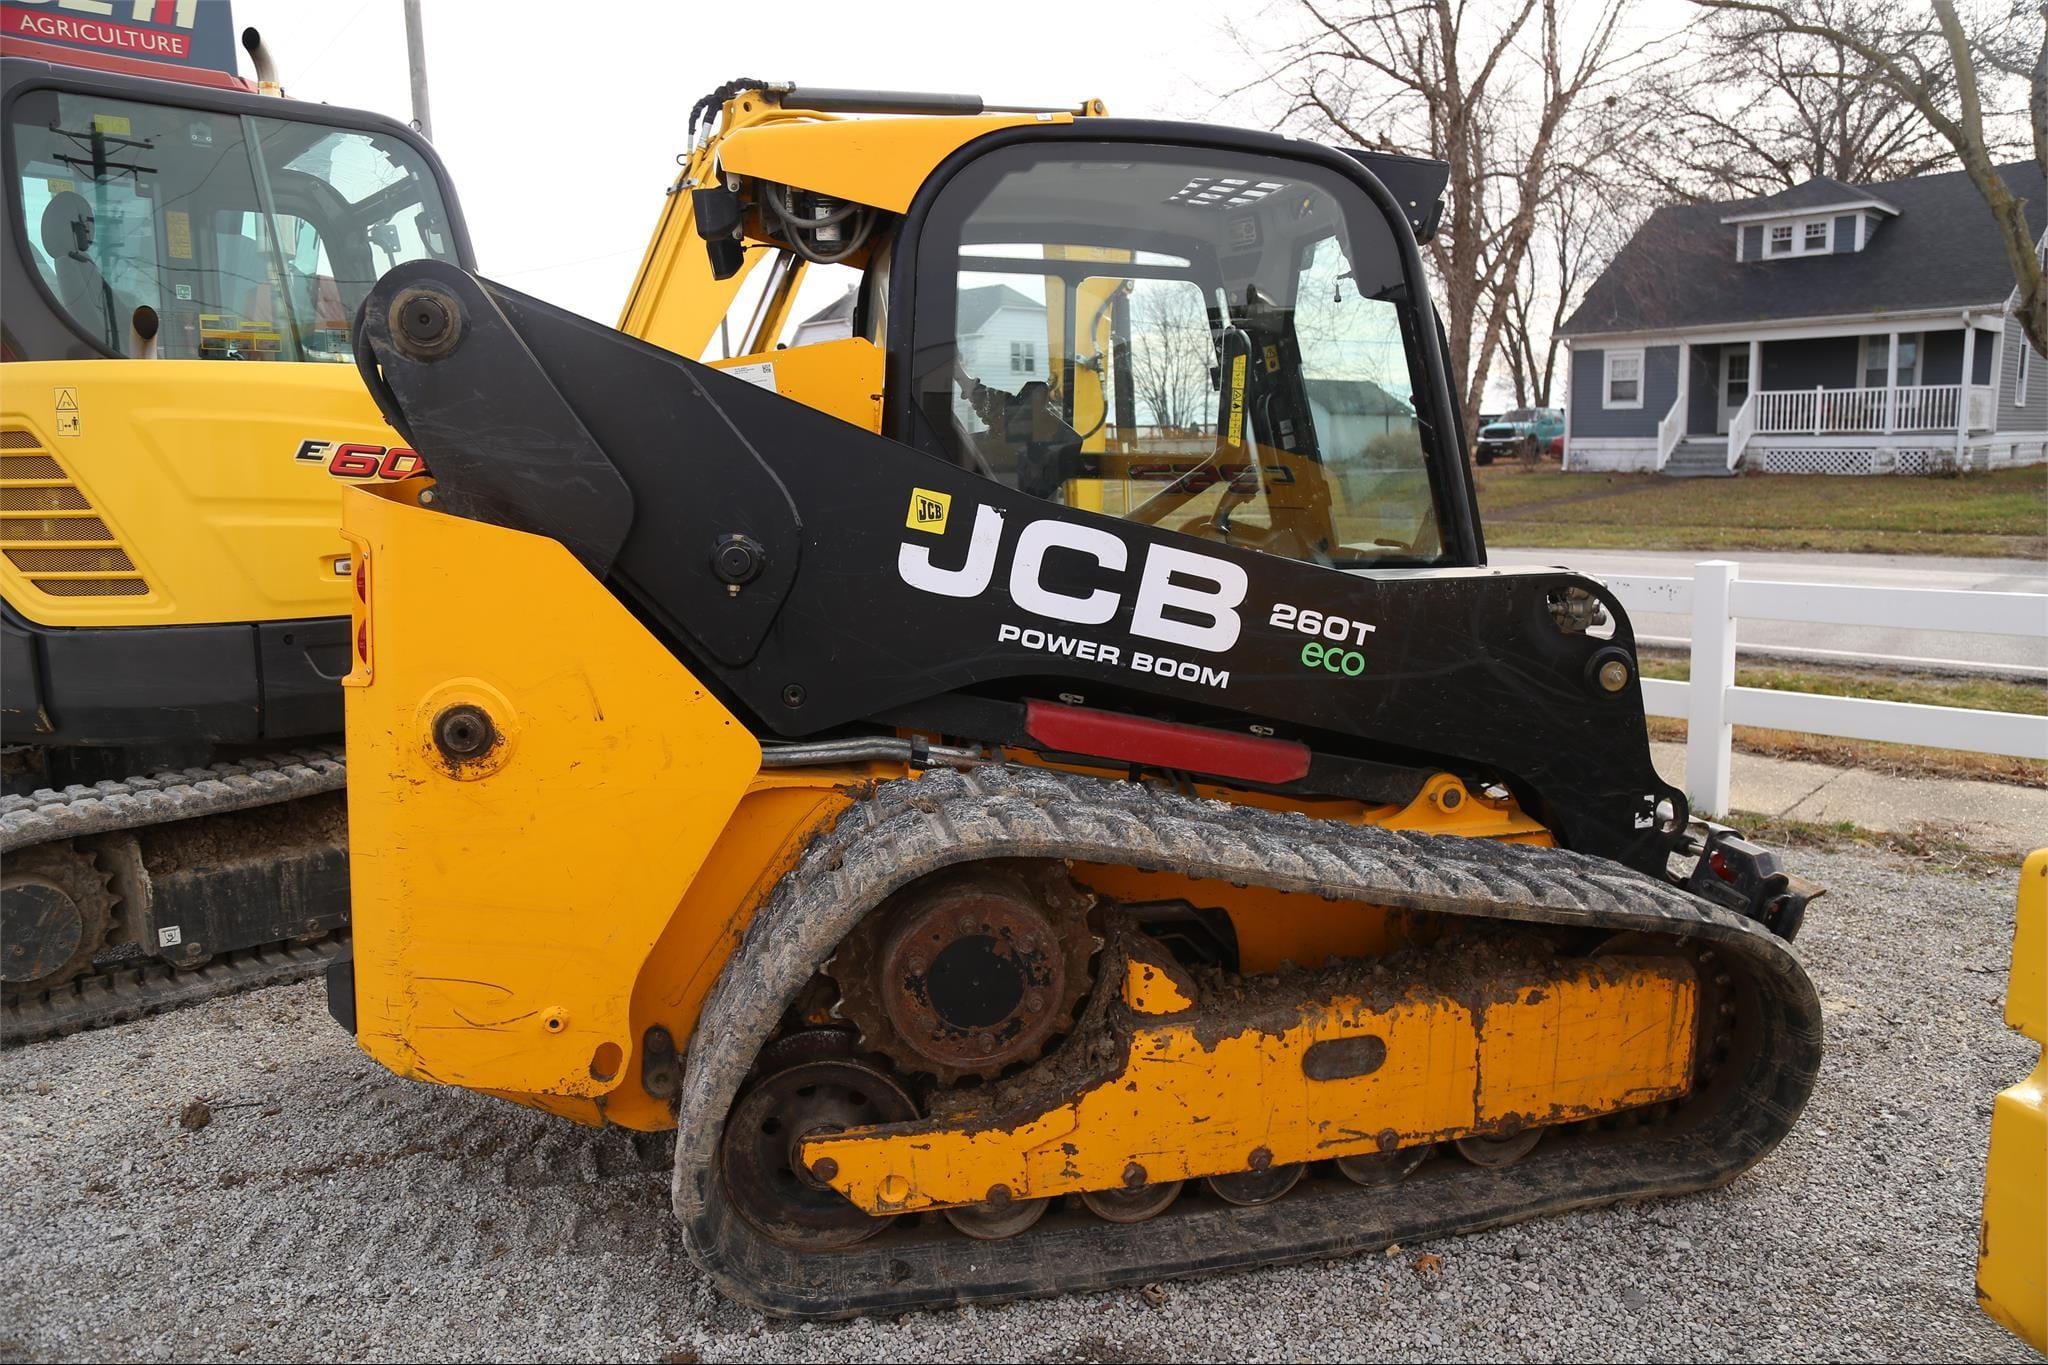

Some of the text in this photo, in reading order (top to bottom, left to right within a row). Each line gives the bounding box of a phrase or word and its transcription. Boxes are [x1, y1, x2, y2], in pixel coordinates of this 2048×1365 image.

[20, 14, 184, 55] AGRICULTURE
[918, 498, 942, 521] JCB
[898, 503, 1249, 653] JCB
[1269, 603, 1377, 646] 260T
[998, 624, 1230, 689] POWER BOOM
[1301, 642, 1366, 677] eco
